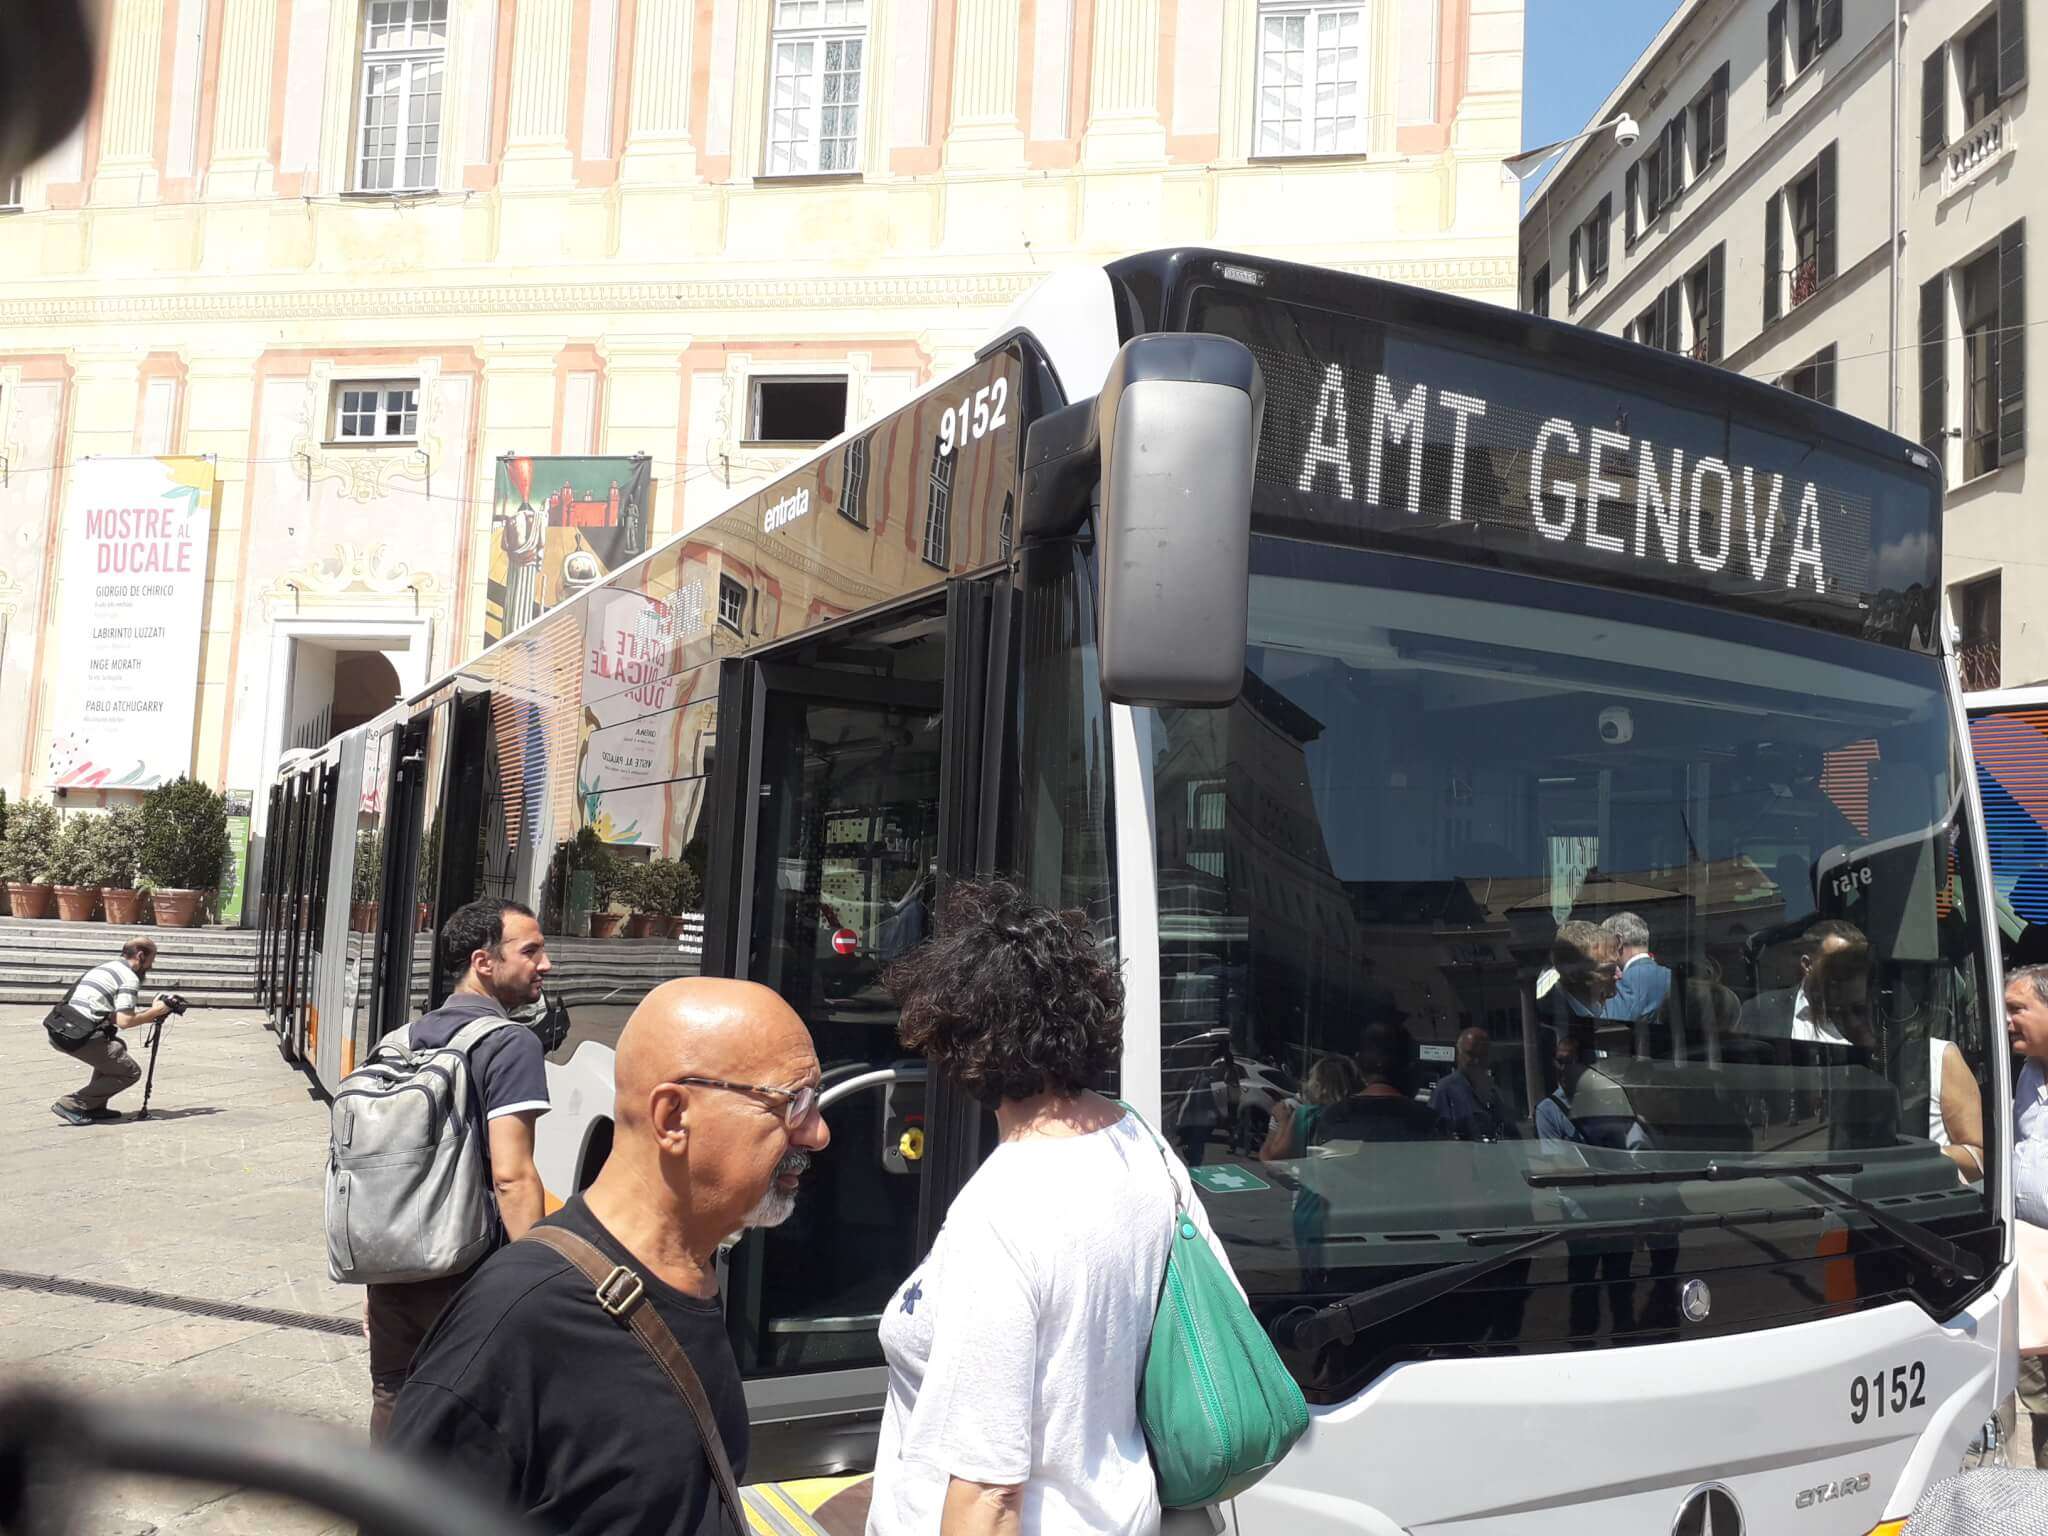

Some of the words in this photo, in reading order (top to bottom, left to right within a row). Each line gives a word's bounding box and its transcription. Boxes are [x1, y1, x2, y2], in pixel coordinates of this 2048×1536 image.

[939, 377, 1007, 456] 9152
[1300, 363, 1487, 520] AMT
[1530, 417, 1827, 594] GENOVA
[85, 508, 174, 539] MOSTRE
[177, 523, 191, 538] AL
[764, 487, 809, 532] entrata
[97, 542, 192, 573] DUCALE
[96, 585, 128, 597] GIORGIO
[130, 585, 140, 597] DE
[142, 584, 174, 597] CHIRICO
[92, 626, 132, 639] LABIRINTO
[134, 626, 165, 638] LUZZATI
[90, 658, 109, 670] INGE
[111, 658, 141, 670] MORATH
[85, 700, 111, 712] PABLO
[113, 700, 164, 712] ATCHUGARRY
[1850, 1361, 1926, 1424] 9152
